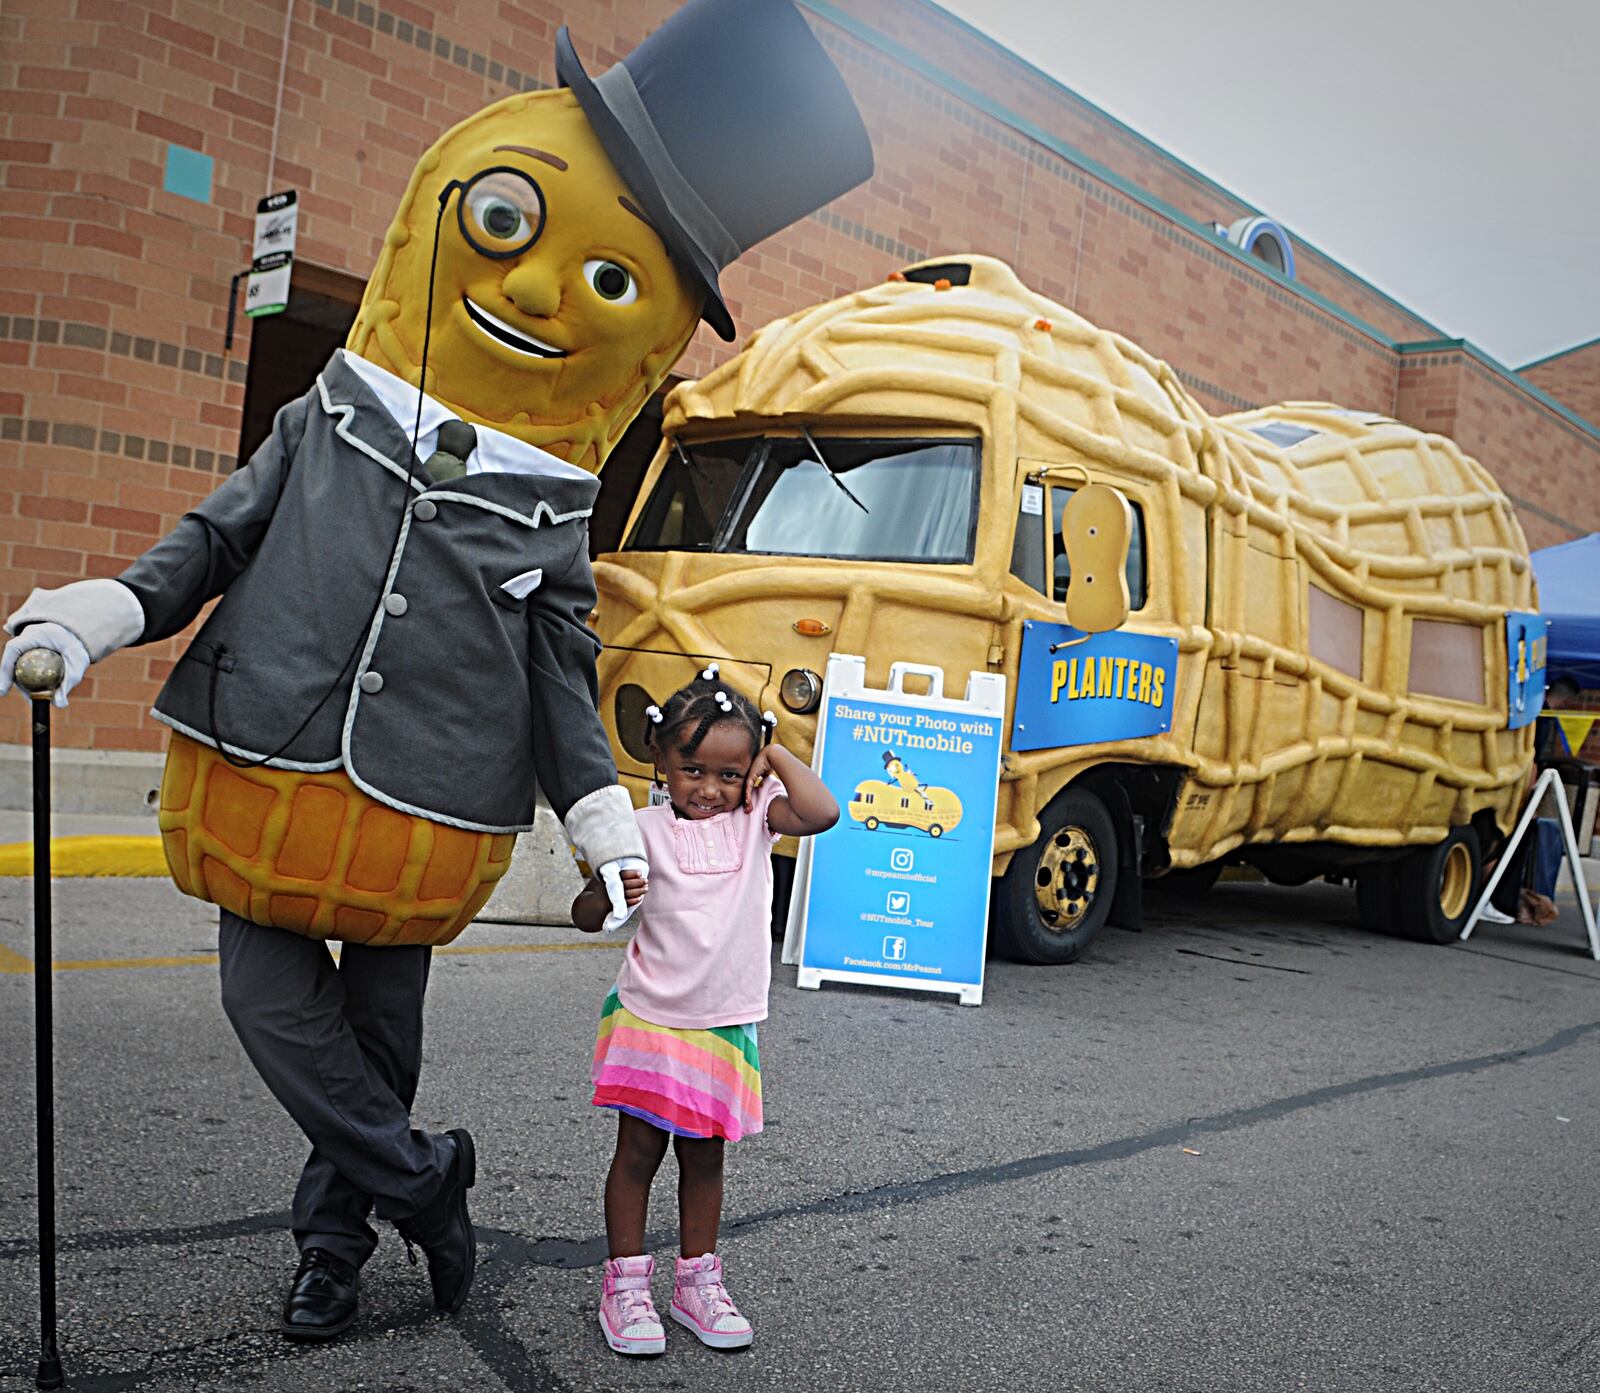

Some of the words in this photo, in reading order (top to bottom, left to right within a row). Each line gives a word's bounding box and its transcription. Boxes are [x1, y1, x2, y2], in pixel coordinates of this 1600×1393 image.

[1050, 656, 1166, 708] PLANTERS
[835, 704, 876, 722] Share
[879, 712, 912, 728] your
[915, 714, 957, 732] Photo
[960, 721, 994, 737] with
[852, 725, 973, 754] #NUTmobile
[860, 913, 935, 928] @NUTmobile_Tour
[843, 957, 942, 974] Facebook.com/MrPeanut
